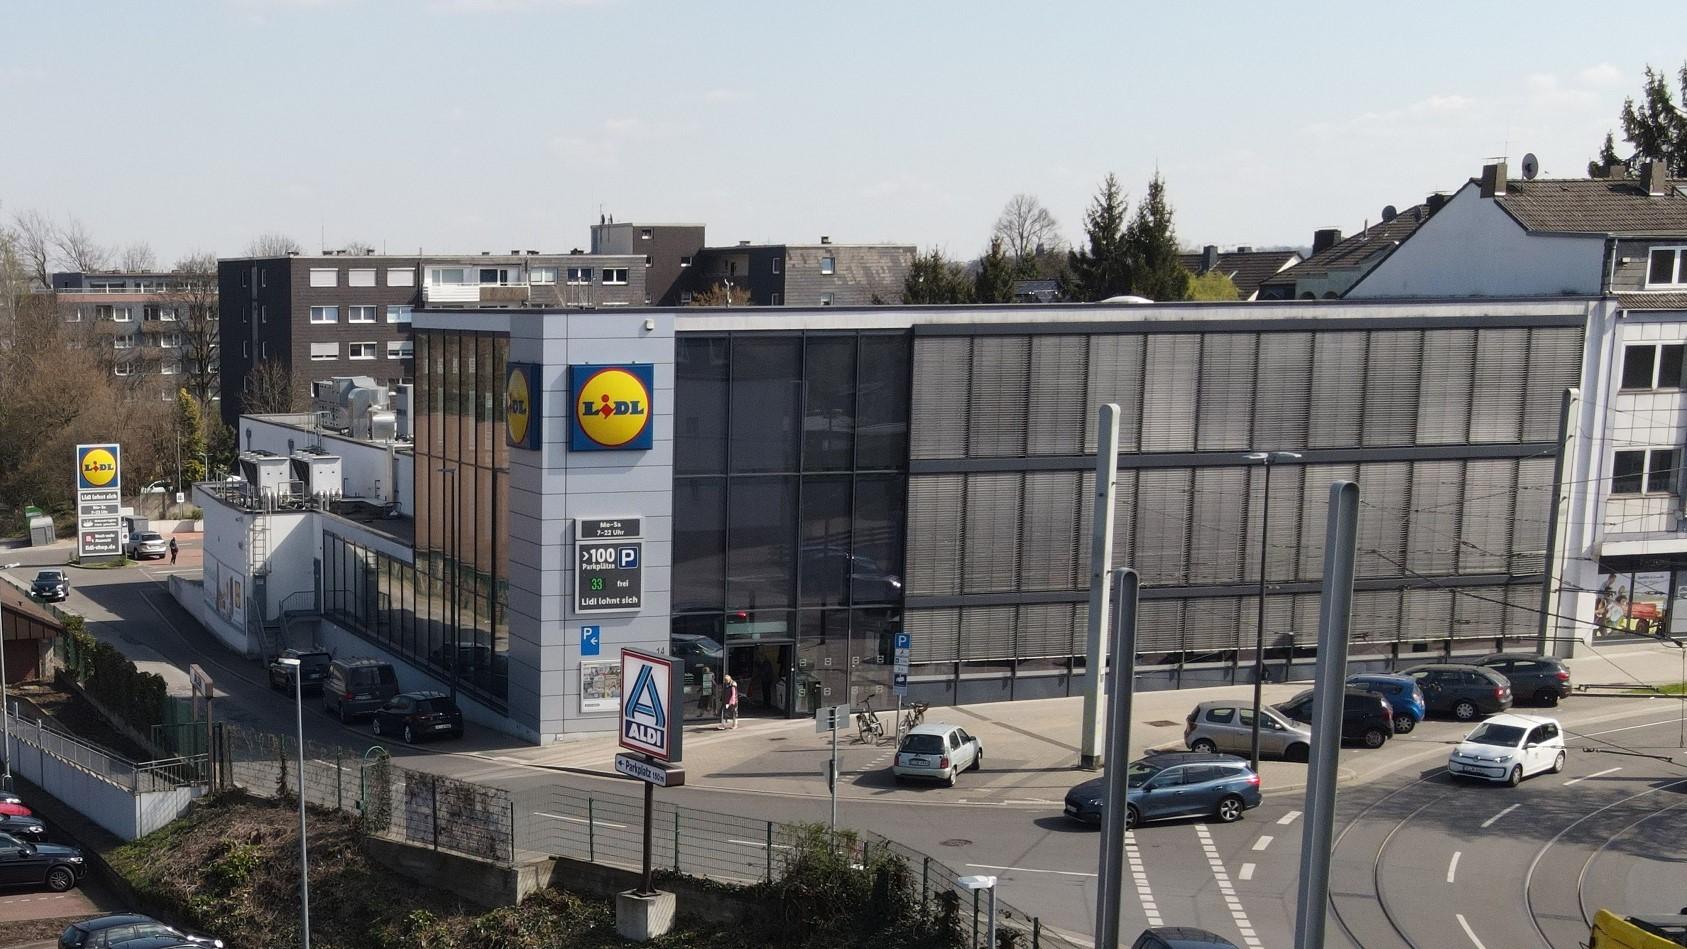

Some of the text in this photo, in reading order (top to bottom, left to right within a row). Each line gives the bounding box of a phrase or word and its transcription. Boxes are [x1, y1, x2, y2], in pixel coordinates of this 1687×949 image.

[621, 549, 635, 566] P
[591, 578, 603, 590] 33
[581, 597, 597, 605] Lidl
[598, 597, 620, 605] lohnt
[583, 627, 592, 640] P
[898, 635, 907, 647] P
[628, 723, 662, 746] ALDI
[625, 760, 652, 778] Parkplatz
